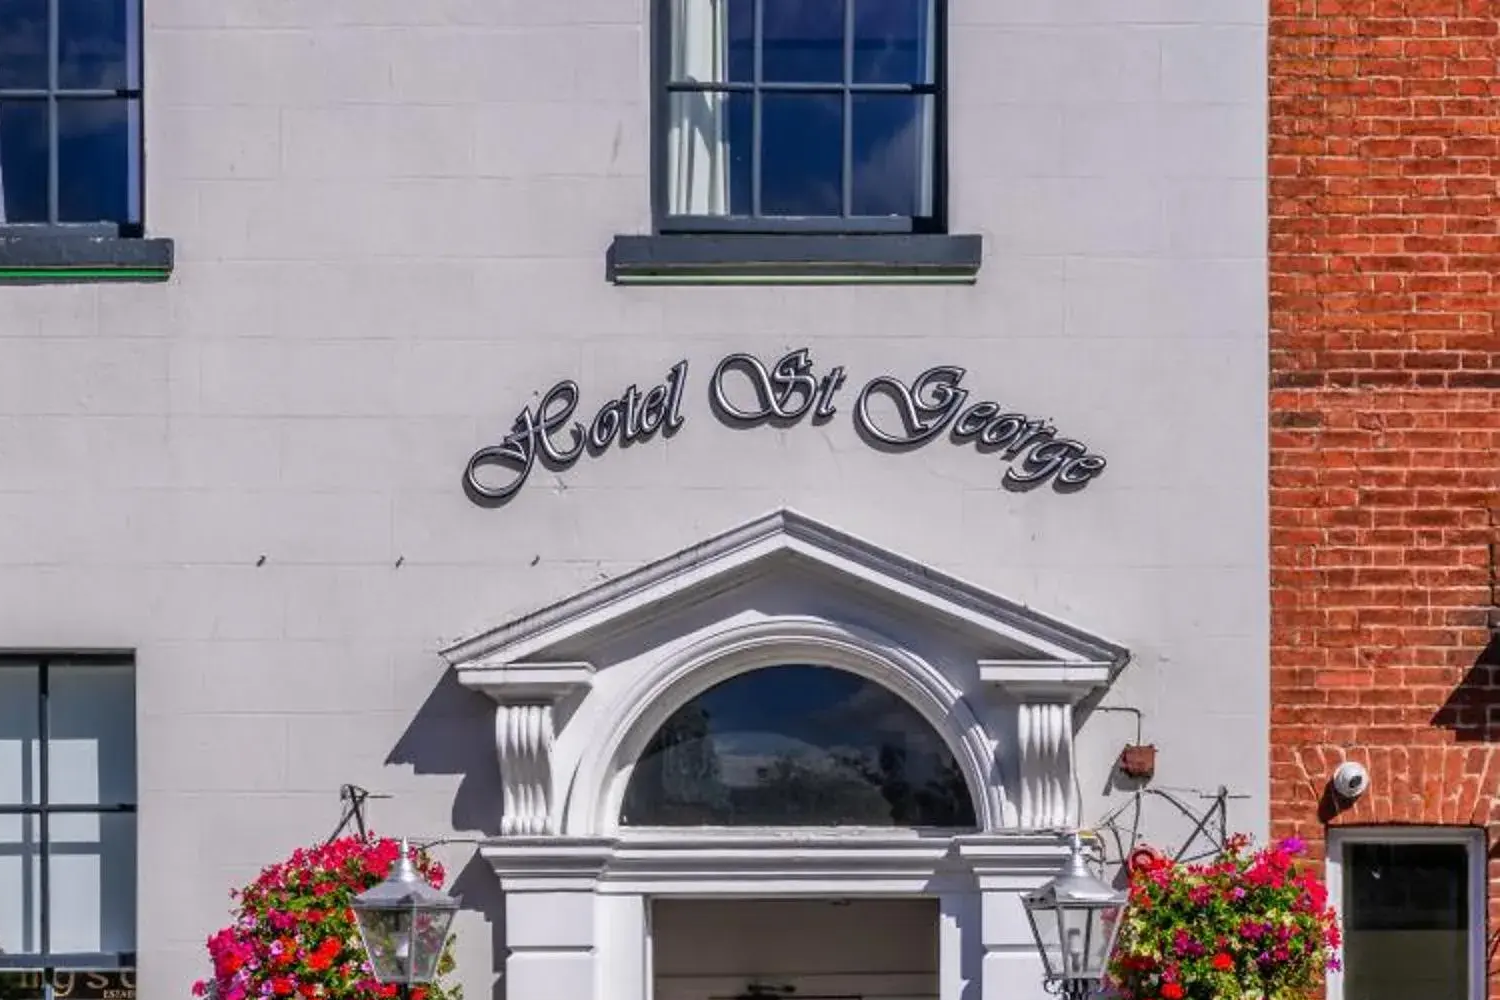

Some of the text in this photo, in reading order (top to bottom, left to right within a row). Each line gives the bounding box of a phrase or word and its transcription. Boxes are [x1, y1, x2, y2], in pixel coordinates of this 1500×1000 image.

[465, 347, 1107, 502] Hotel St George
